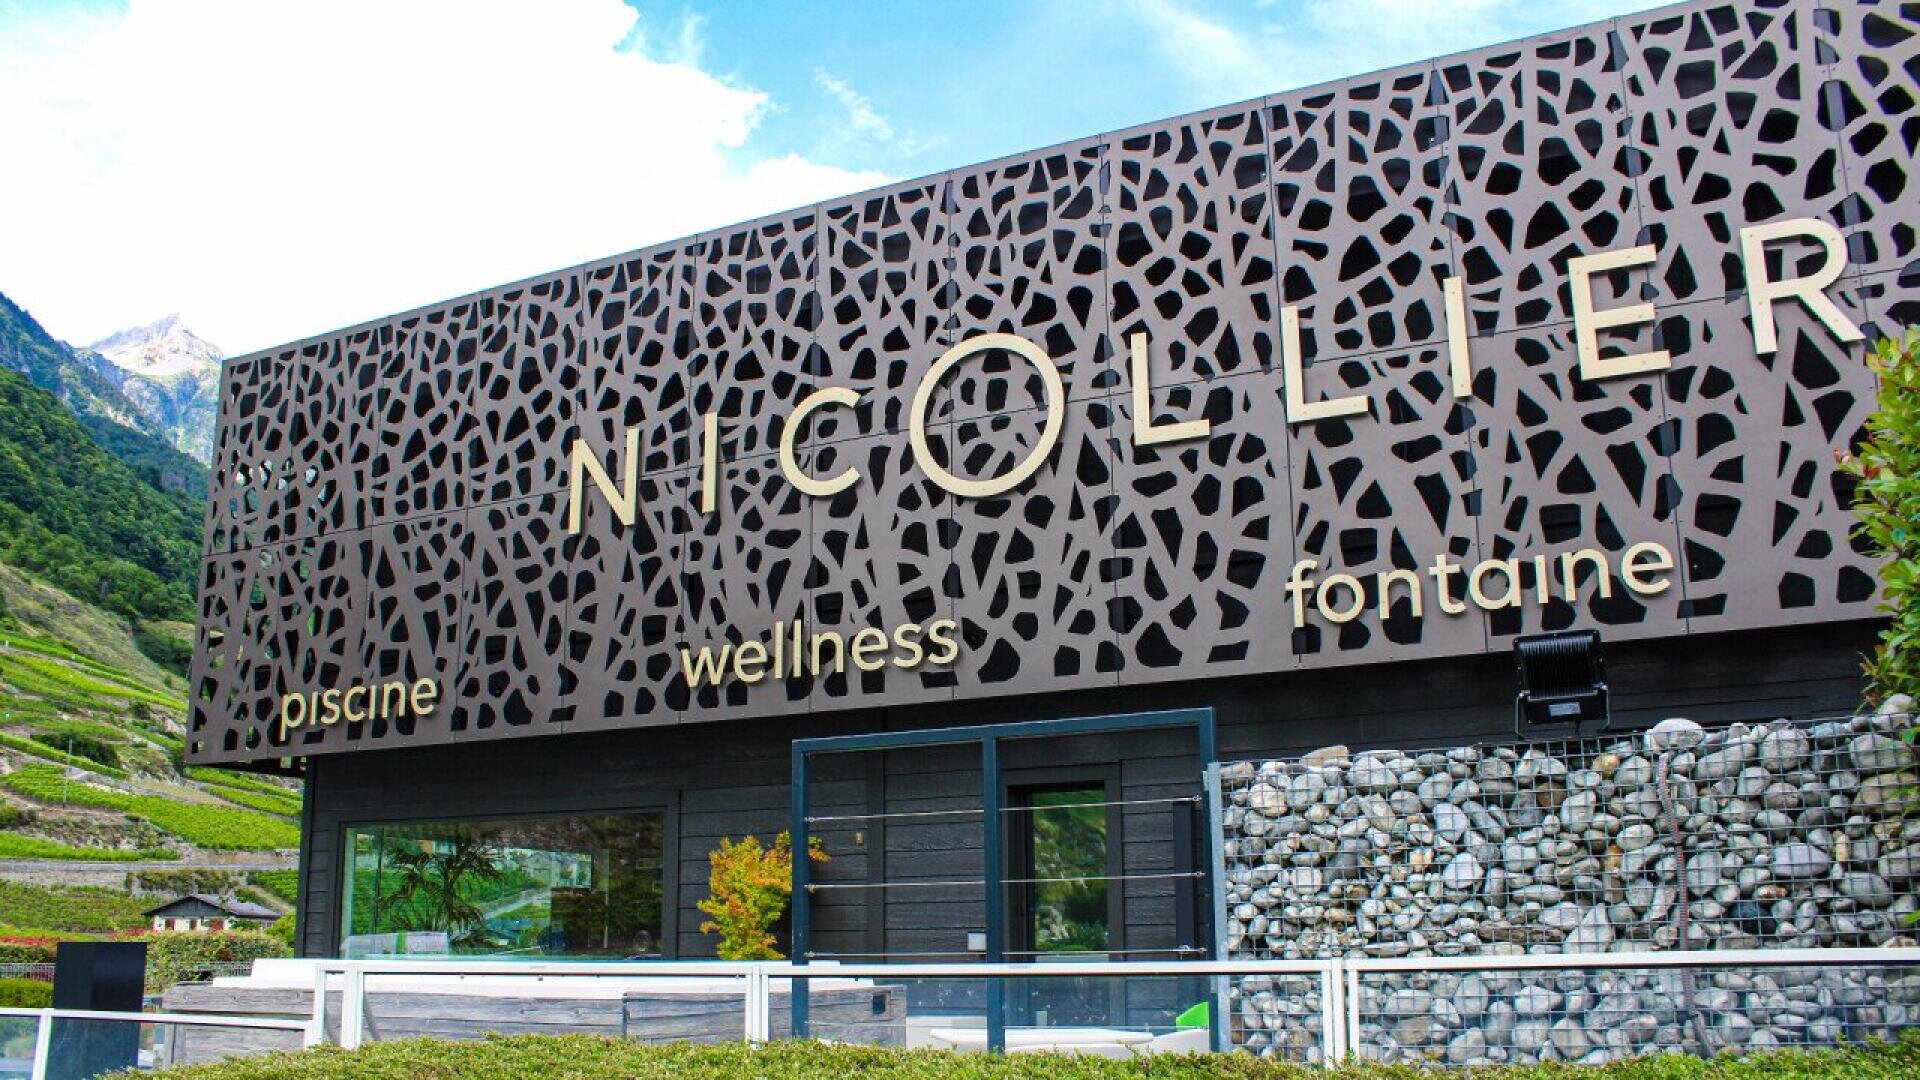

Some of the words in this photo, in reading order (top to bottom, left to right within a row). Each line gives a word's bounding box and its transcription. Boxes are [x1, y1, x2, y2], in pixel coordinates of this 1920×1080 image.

[568, 217, 1867, 535] NICOLLIER
[1285, 541, 1675, 628] fontaine
[680, 617, 961, 689] wellness
[278, 674, 439, 740] piscine
